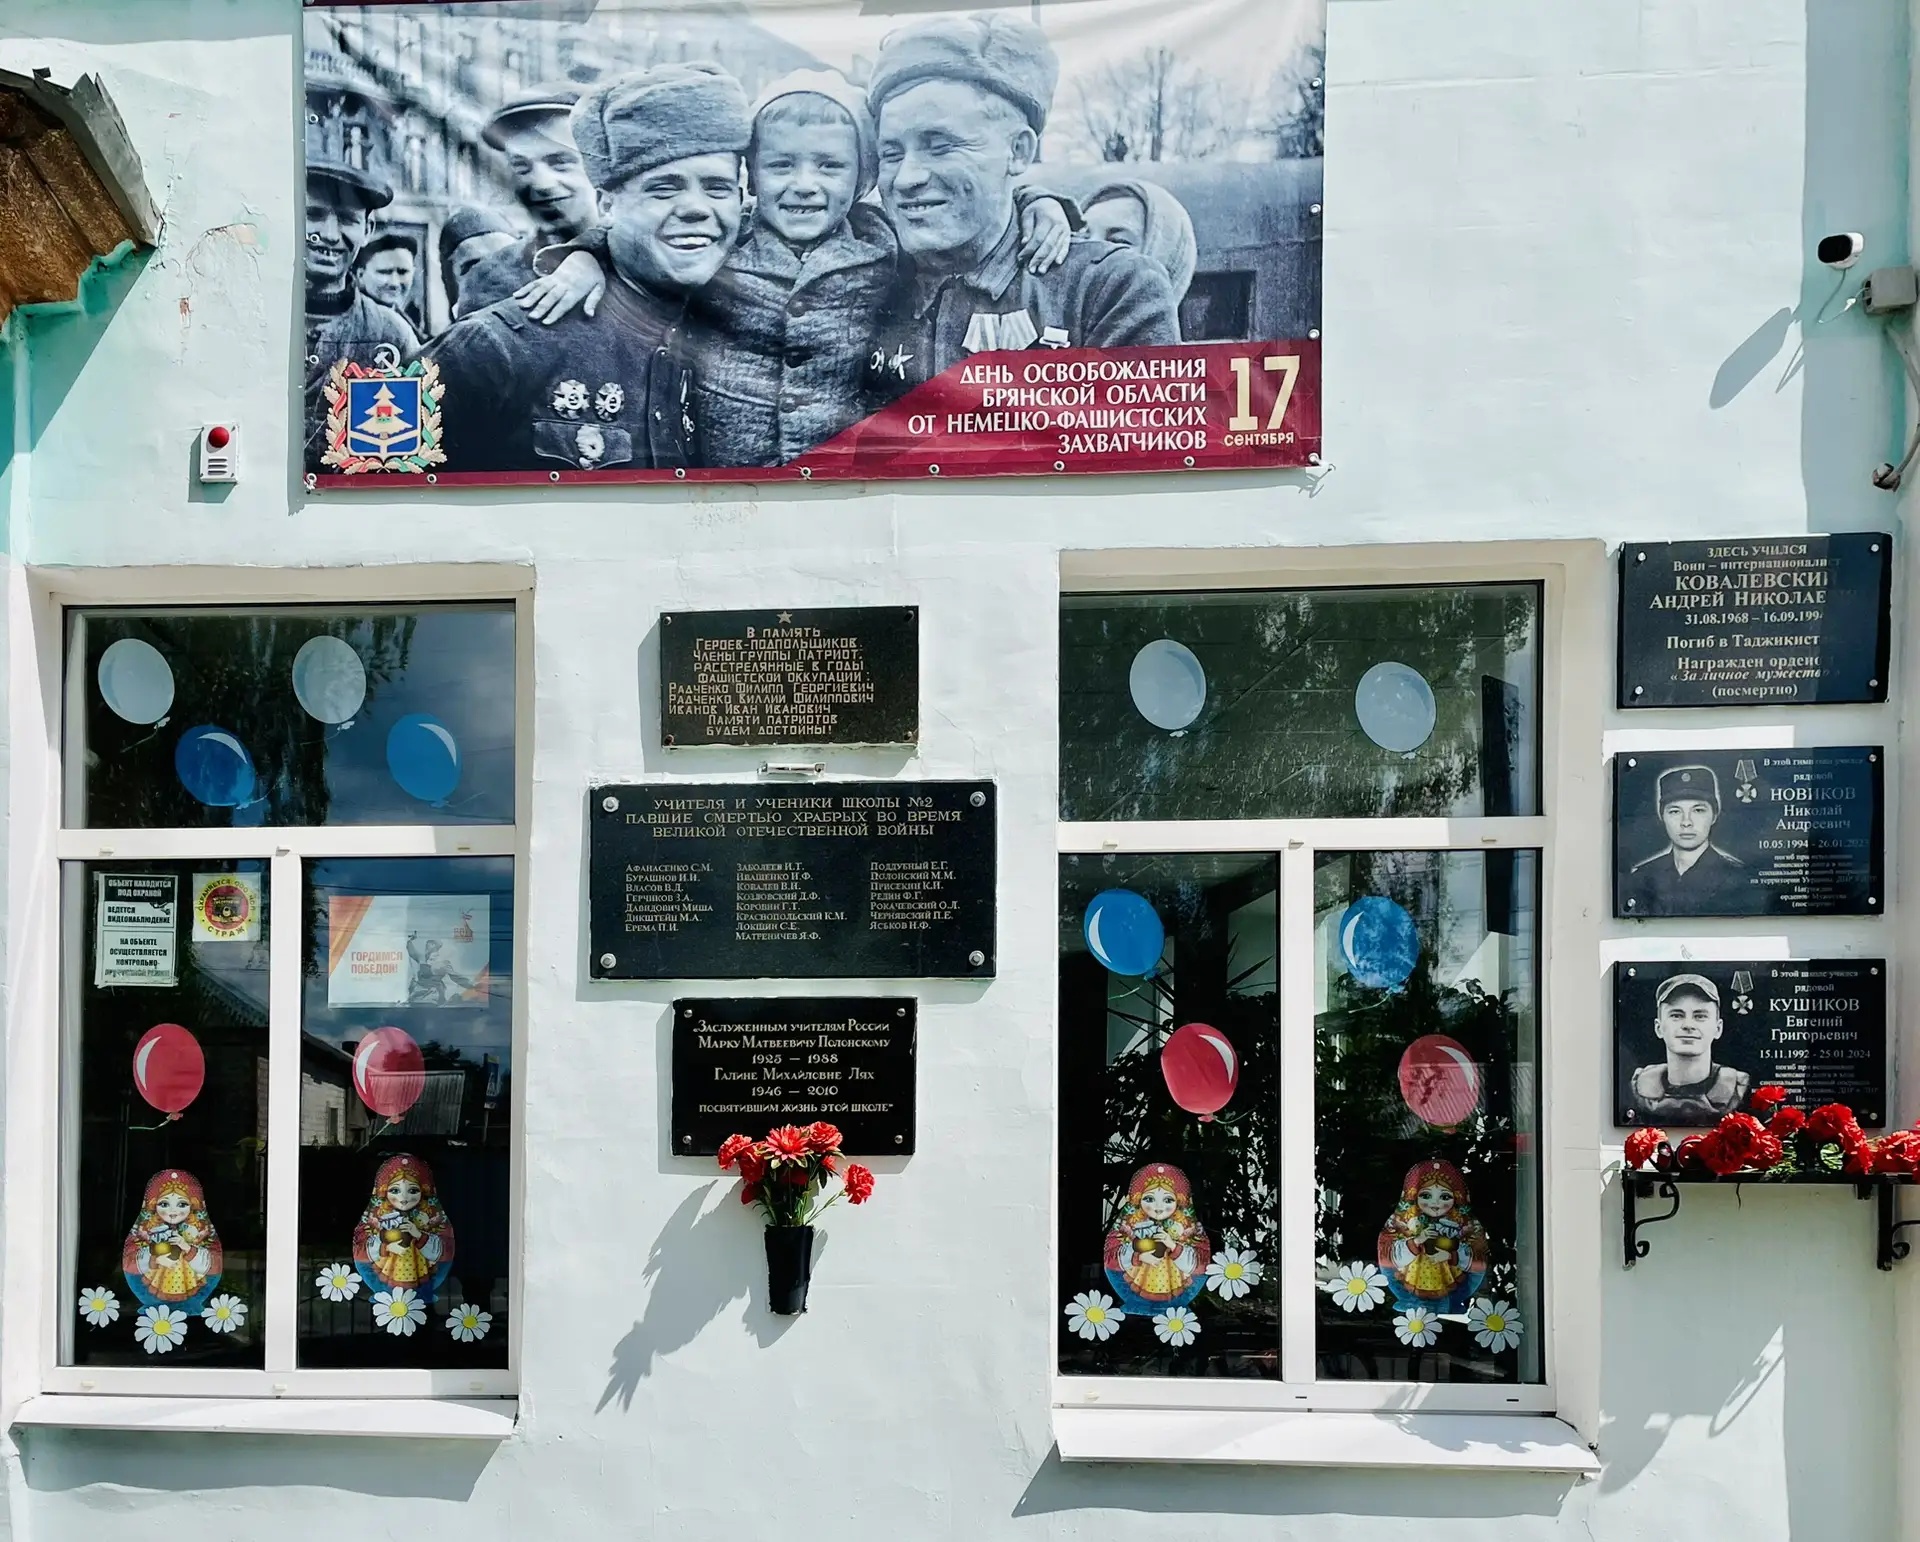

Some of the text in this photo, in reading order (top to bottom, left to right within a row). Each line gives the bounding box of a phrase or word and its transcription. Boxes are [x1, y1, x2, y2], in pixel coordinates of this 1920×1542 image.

[960, 358, 1207, 385] ДЕНЬ ОСВОБОЖДЕНИЯ
[982, 383, 1207, 408] БРЯНСКОЙ ОБЛАСТИ
[1229, 355, 1301, 431] 17
[907, 405, 1207, 435] ОТ НЕМЕЦКО-ФАШИСТСКИХ
[1058, 430, 1207, 455] ЗАХВАТЧИКОВ
[1707, 544, 1807, 559] ЗДЕСЬ УЧИЛСЯ
[1673, 560, 1705, 572] Воин
[1649, 590, 1838, 610] АНДРЕЙ НИКОЛАЕ
[1684, 612, 1749, 625] 31.08.1968
[746, 626, 821, 639] В ПАМЯТЬ
[1667, 633, 1833, 649] Погиб в Таджикист
[693, 649, 791, 661] ЧЛЕНЫ ГРУППЫ
[693, 660, 864, 673] РАССТРЕЛЯННЫЕ В ГОДЫ
[1677, 655, 1830, 673] Награжден ордено
[1699, 670, 1750, 682] личное
[668, 682, 874, 694] РАДЧЕНКО ФИЛИПП ГЕОРГИЕВИЧ
[1711, 683, 1798, 699] (посмертно)
[668, 692, 874, 705] РАДЧЕНКО ФИЛИППОВИЧ
[668, 703, 831, 715] ИВАНОВ ИВАН ИВАНОВИЧ
[708, 714, 838, 725] ПАМЯТИ ПАТРИОТОВ
[706, 724, 832, 736] БУДЕМ ДОСТОЙНЫ!
[1771, 757, 1791, 766] этой
[1793, 771, 1833, 784] рядовой
[1770, 786, 1856, 801] НОВИКОВ
[653, 796, 935, 810] УЧИТЕЛЯ И УЧЕНИКИ ШКОЛЫ №2
[1783, 802, 1843, 817] Николай
[625, 810, 962, 825] ПАВШИЕ СМЕРТЬЮ ХРАБРЫХ ВО ВРЕМЯ
[652, 822, 935, 838] ВЕЛИКОЙ ОТЕЧЕСТВЕННОЙ ВОЙНЫ
[1776, 818, 1851, 833] Андреевич
[1758, 839, 1809, 849] 10.05.1994
[626, 863, 689, 873] АФАНАСЕНКО
[870, 861, 929, 871] ПОДДУБНЫЙ
[870, 870, 957, 881] ПОЛОНСКИЙ М.М.
[108, 879, 172, 888] ОБЪЕКТ НАХОДИТСЯ
[625, 883, 684, 893] ВЛАСОВ В.Д.
[736, 882, 779, 891] КОВАЛЕВ
[117, 888, 162, 897] ПОД ОХРАНОЙ
[798, 891, 821, 901] Д.Ф.
[107, 906, 136, 915] ВЕДЕТСЯ
[624, 903, 714, 913] ДАВИДОВИЧ МИША
[107, 915, 171, 924] ВИДЕОНАБЛЮДЕНИЕ
[679, 913, 703, 922] М.А.
[735, 911, 848, 921] КРАСНОПОЛЬСКИЙ К.М.
[207, 925, 245, 937] СТРАЖ
[625, 923, 657, 932] ЕРЕМА
[119, 938, 158, 946] НА ОБЪЕКТЕ
[109, 948, 168, 957] ОСУЩЕСТВЛЯЕТСЯ
[351, 951, 403, 963] ГОРДИМСЯ
[1771, 969, 1779, 978] В
[1780, 969, 1800, 978] этой
[1794, 983, 1835, 995] рядовой
[1769, 997, 1860, 1012] КУШИКОВ
[790, 1022, 846, 1033] УЧИТЕЛЯМ
[847, 1018, 890, 1032] РОССИИ
[1785, 1013, 1844, 1028] Евгений
[698, 1034, 891, 1049] МАРКУ МАТВЕЕВИЧУ ПОЛОНСКОМУ
[1770, 1028, 1858, 1044] Григорьевич
[751, 1053, 839, 1065] 1925 1988
[1759, 1049, 1810, 1059] 15.11.1992
[714, 1066, 875, 1081] ГАЛИНЕ МИХАЙЛОВНЕ ЛЯХ
[751, 1085, 839, 1097] 1946 2010
[699, 1103, 779, 1113] ПОСВЯТИВШИМ
[780, 1103, 818, 1113] ЖИЗНЬ
[820, 1101, 849, 1113] ЭТОЙ
